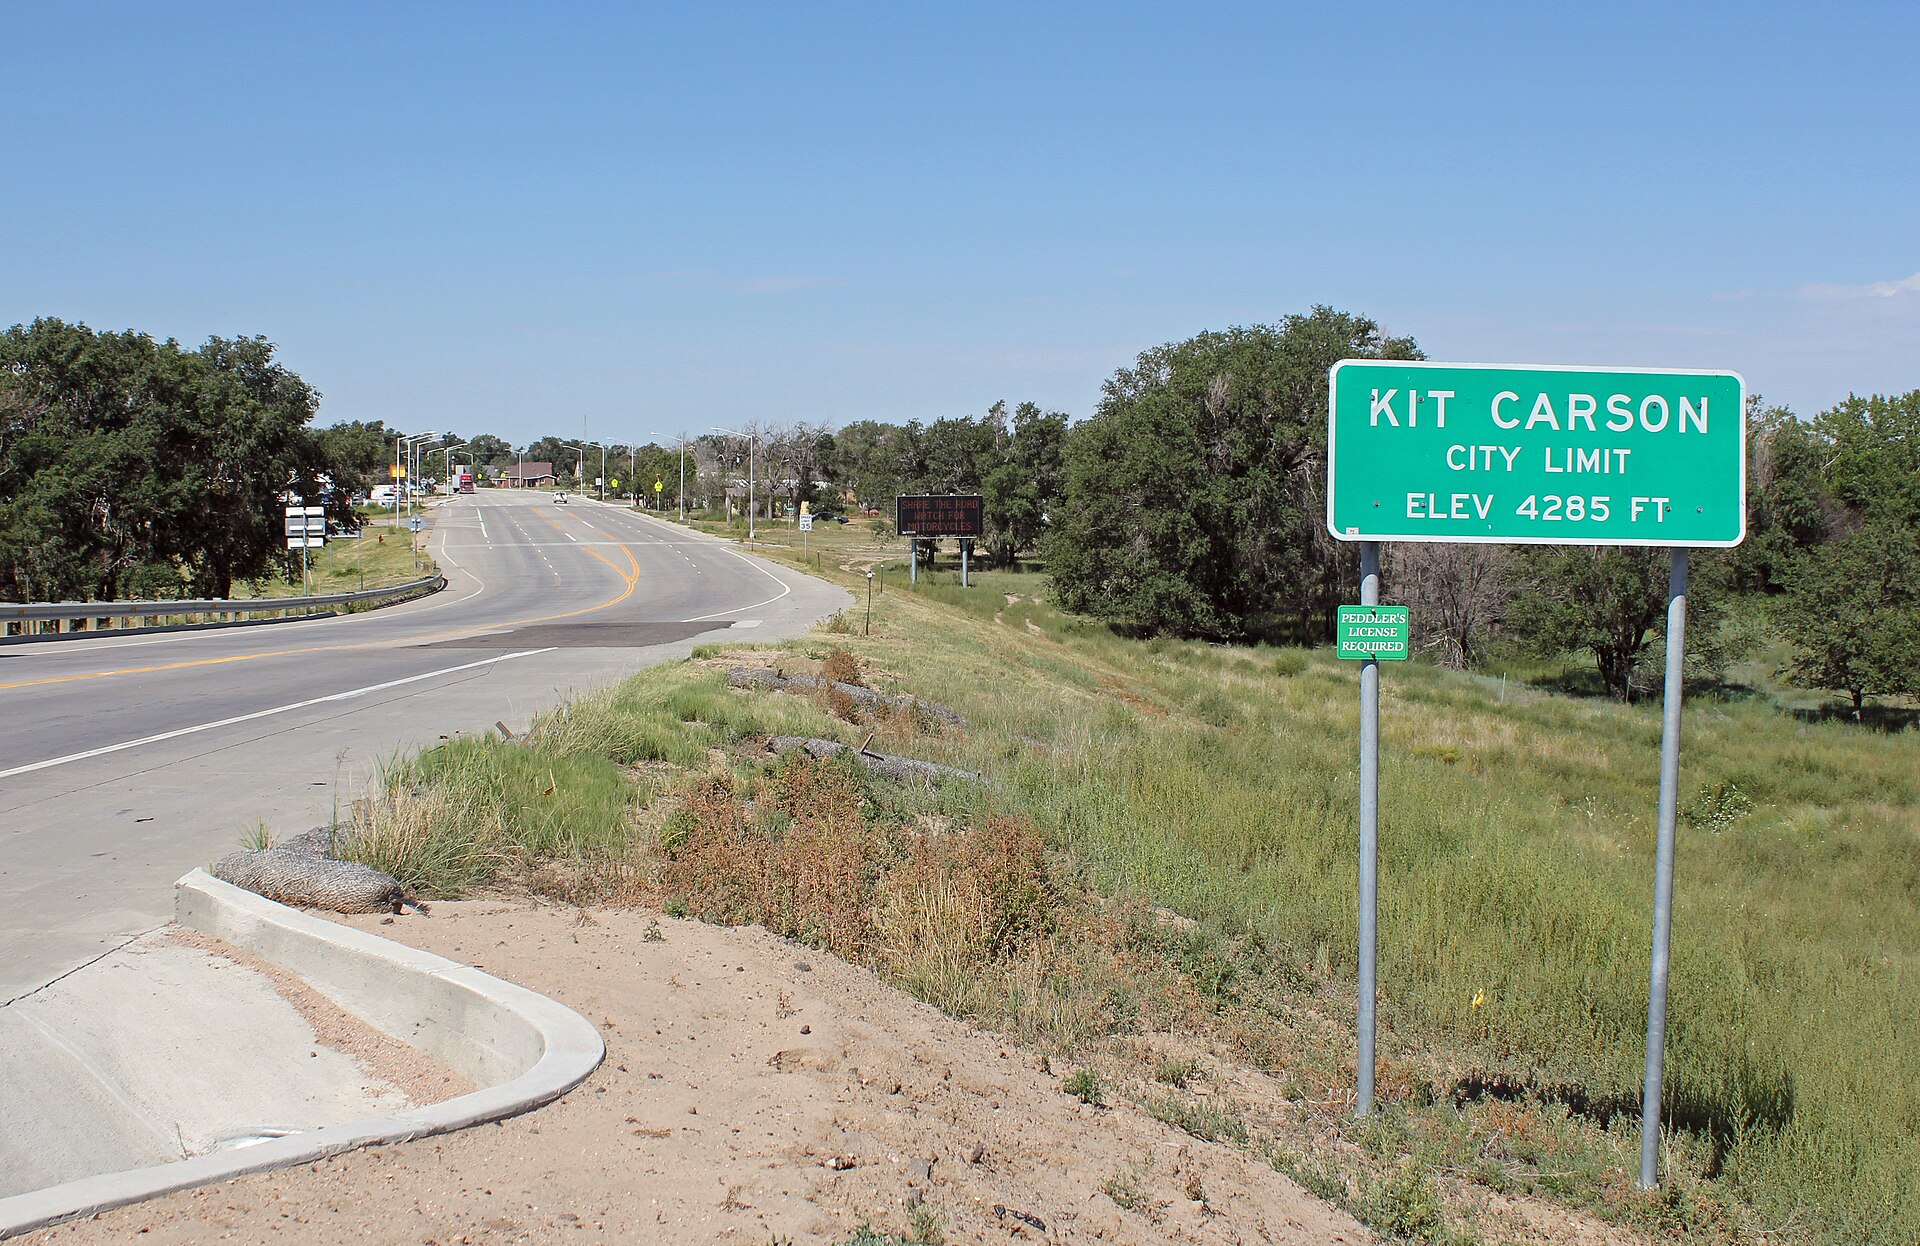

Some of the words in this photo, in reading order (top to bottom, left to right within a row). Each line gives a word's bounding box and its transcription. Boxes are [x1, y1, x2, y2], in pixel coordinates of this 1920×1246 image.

[1370, 388, 1455, 428] KIT
[1490, 390, 1708, 434] CARSON
[1446, 444, 1521, 472] CITY
[1545, 447, 1631, 474] LIMIT
[902, 500, 929, 509] SHARE
[935, 500, 952, 509] THE
[956, 500, 978, 509] ROAD
[1406, 492, 1494, 520] ELEV
[1515, 494, 1610, 522] 4285
[1631, 496, 1669, 523] FT
[914, 511, 944, 519] WATCH
[948, 511, 965, 519] FOR
[908, 522, 972, 531] MOTORCYCLES
[1341, 613, 1406, 624] PEDDLER'S
[1348, 627, 1398, 637] LICENSE
[1341, 641, 1405, 654] REQUIRED
